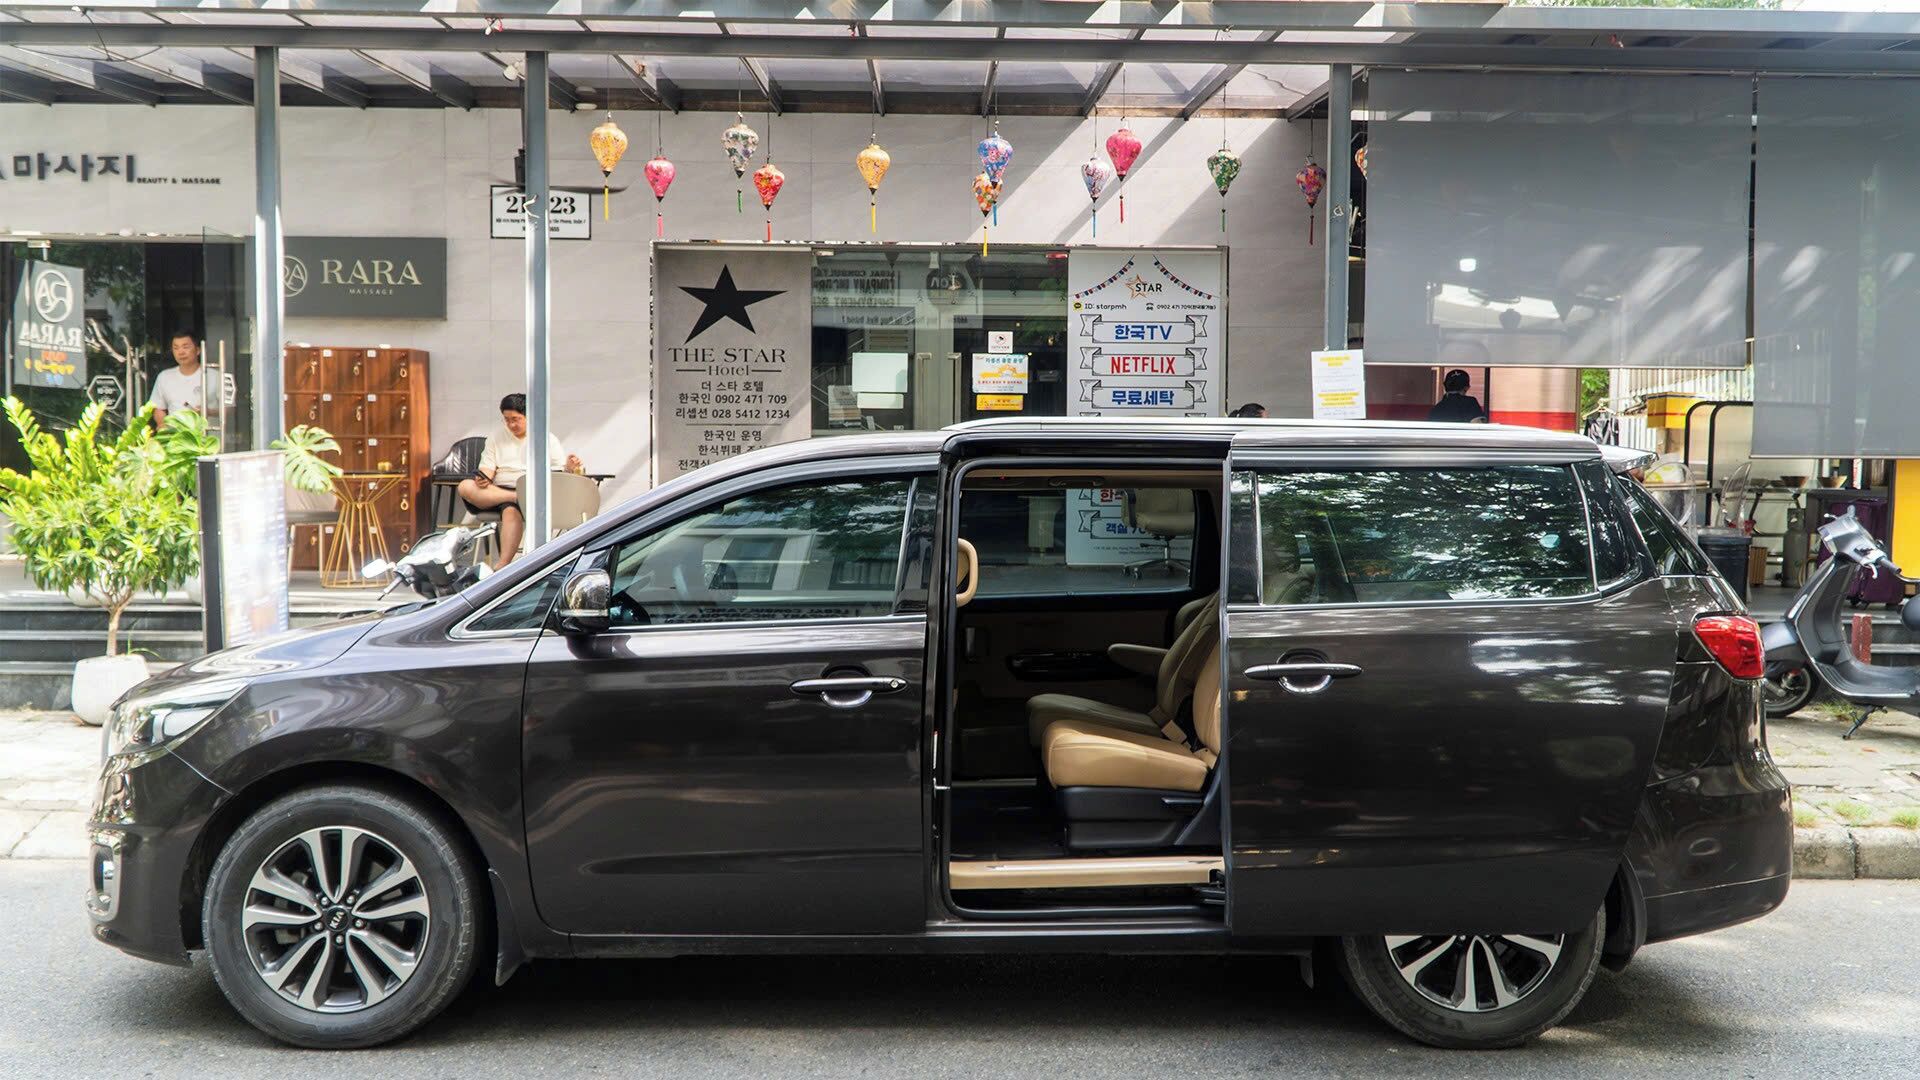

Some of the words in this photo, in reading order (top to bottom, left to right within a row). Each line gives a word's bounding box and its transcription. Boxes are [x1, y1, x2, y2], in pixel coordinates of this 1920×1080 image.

[13, 152, 134, 183] 마사지
[550, 196, 576, 214] 23
[320, 259, 422, 286] RARA
[349, 288, 394, 296] MASSAGE
[1135, 282, 1163, 292] STAR
[1096, 303, 1127, 311] starpmh
[1114, 325, 1173, 341] 한국TV
[668, 348, 715, 362] THE
[724, 348, 786, 363] STAR
[708, 365, 750, 376] Hotel
[1111, 356, 1176, 375] NETFLIX
[701, 381, 711, 391] 더
[716, 381, 738, 391] 스타
[742, 381, 764, 392] 호텔
[678, 393, 711, 404] 한국인
[715, 395, 741, 404] 0902
[744, 395, 763, 404] 471
[768, 395, 788, 404] 709
[1112, 390, 1175, 406] 무료세탁
[675, 407, 708, 419] 리셉션
[711, 409, 732, 418] 028
[735, 409, 760, 418] 5412
[765, 409, 790, 418] 1234
[703, 430, 736, 441] 한국인
[741, 430, 762, 441] 운영
